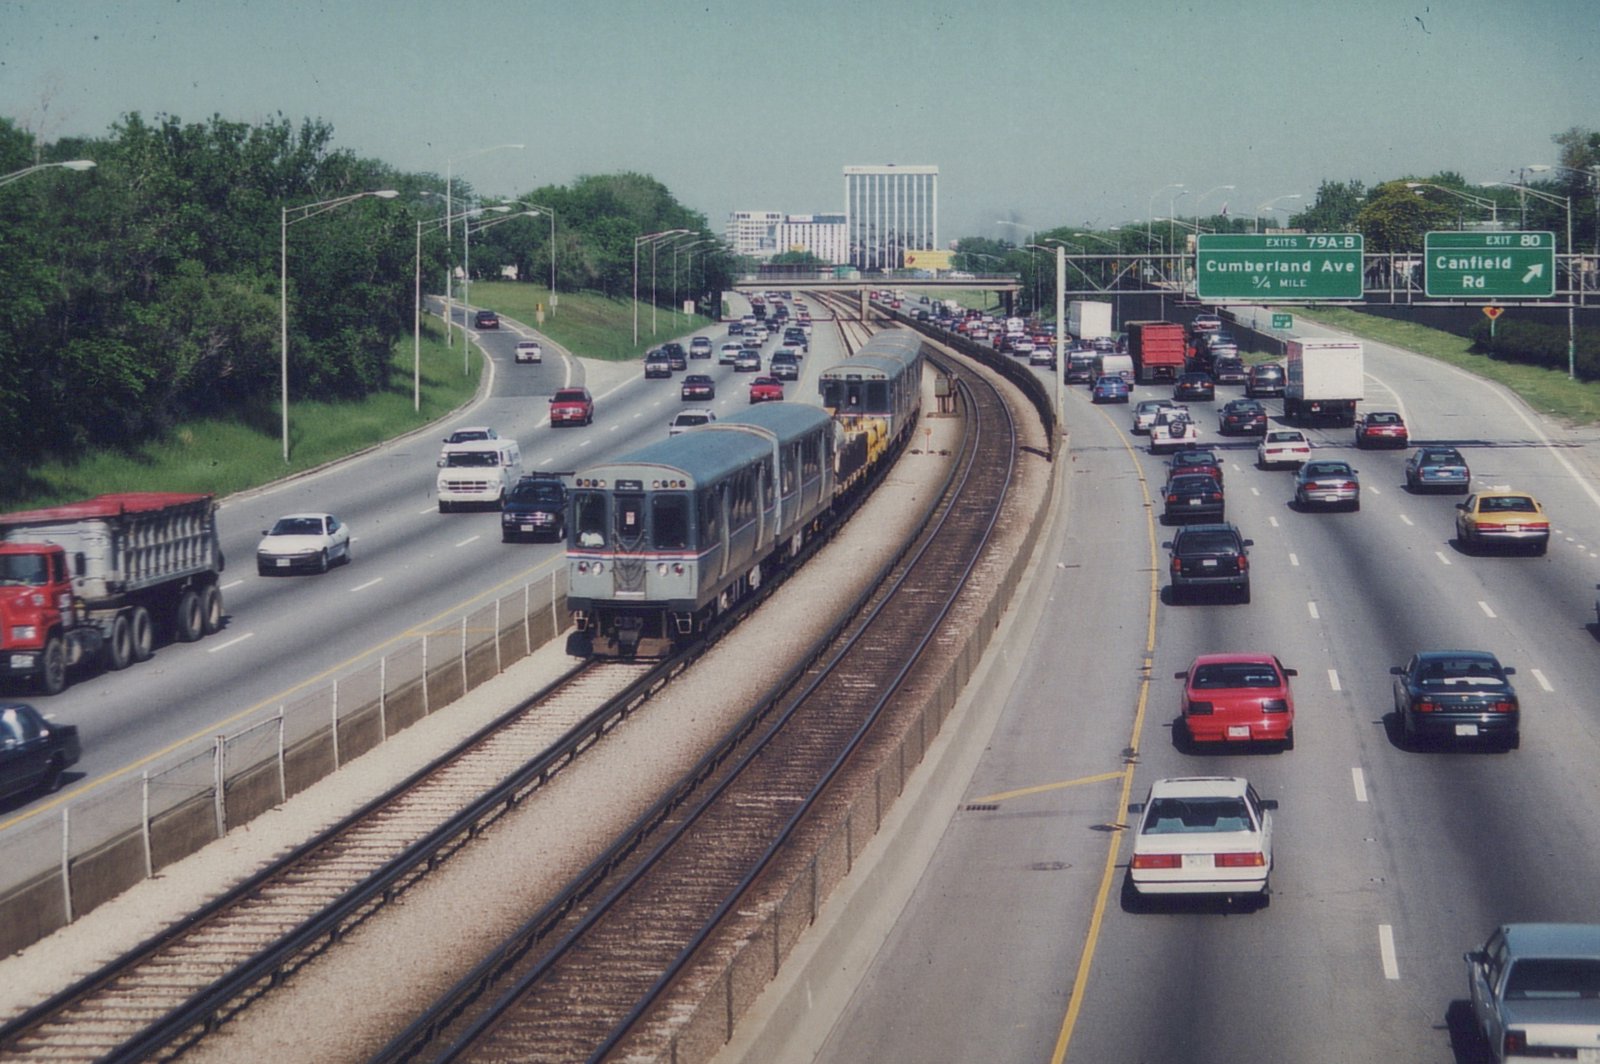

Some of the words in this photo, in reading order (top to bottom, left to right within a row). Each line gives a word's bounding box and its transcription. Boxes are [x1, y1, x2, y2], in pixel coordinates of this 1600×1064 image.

[1266, 238, 1298, 247] EXITS
[1306, 236, 1355, 249] 79A-B
[1486, 235, 1512, 245] EXIT
[1520, 234, 1541, 247] 80
[1206, 260, 1311, 272] Cumberland
[1321, 260, 1355, 272] Ave
[1436, 256, 1512, 270] Canfield
[1279, 279, 1307, 288] MILE
[1462, 275, 1485, 288] Rd
